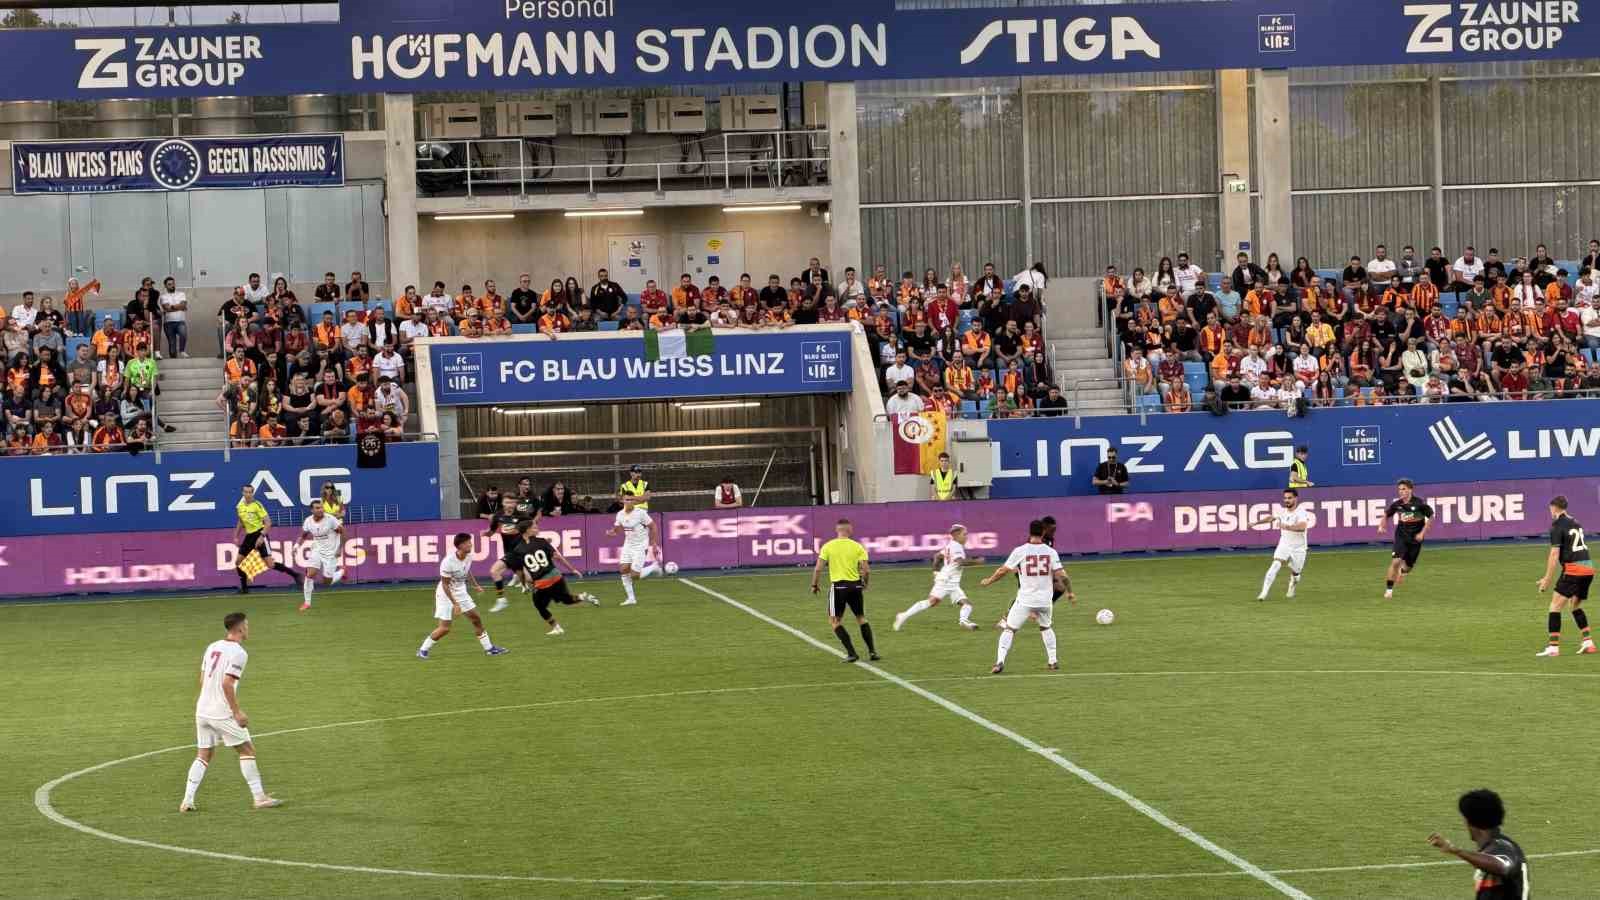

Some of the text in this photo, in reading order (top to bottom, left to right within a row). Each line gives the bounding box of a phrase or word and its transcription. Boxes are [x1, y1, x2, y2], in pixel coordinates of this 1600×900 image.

[505, 0, 614, 19] Personal
[1459, 1, 1580, 26] ZAUNER
[134, 36, 263, 61] ZAUNER
[635, 22, 887, 73] STADION
[960, 17, 1161, 65] STIGA
[1459, 26, 1563, 51] GROUP
[135, 62, 245, 88] GROUP
[28, 150, 144, 179] BLAU WEISS FANS
[207, 145, 326, 174] GEGEN RASSISMUS
[456, 356, 467, 365] FC
[815, 344, 827, 353] FC
[500, 352, 785, 383] FC BLAU WEISS LINZ
[808, 364, 836, 379] LINZ
[448, 376, 477, 391] LINZ
[992, 431, 1294, 479] LINZ AG
[1348, 447, 1375, 462] LINZ
[1507, 427, 1600, 459] LIW
[30, 467, 352, 517] LINZ AG
[1321, 498, 1386, 528] THE
[371, 535, 439, 564] THE
[523, 549, 549, 573] 99
[1026, 554, 1051, 577] 23
[209, 651, 222, 678] 7
